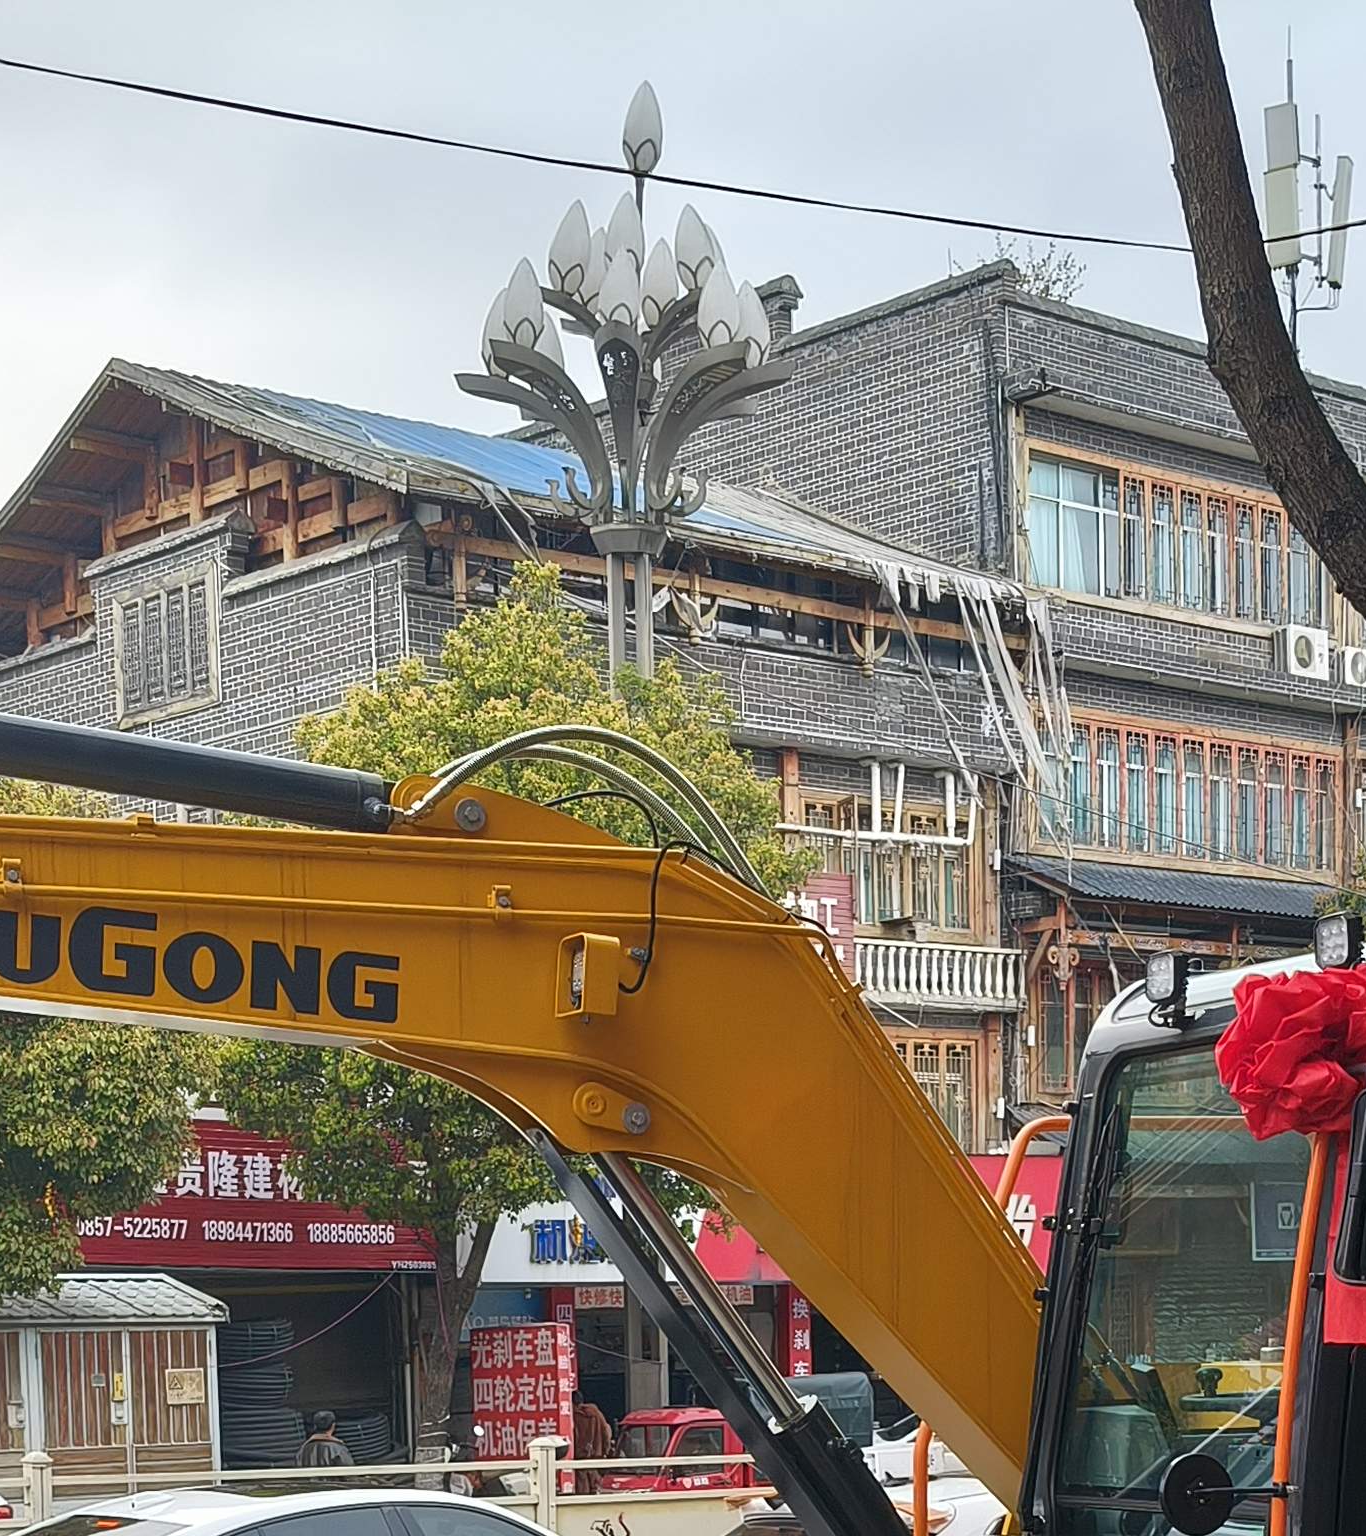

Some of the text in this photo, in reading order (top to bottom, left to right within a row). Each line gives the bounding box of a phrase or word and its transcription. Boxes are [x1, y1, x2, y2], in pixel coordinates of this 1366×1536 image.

[202, 1220, 293, 1242] 18984471366
[307, 1223, 395, 1244] 18885665856
[472, 1328, 556, 1369] 光刹车盘
[473, 1373, 557, 1413] 四轮定位
